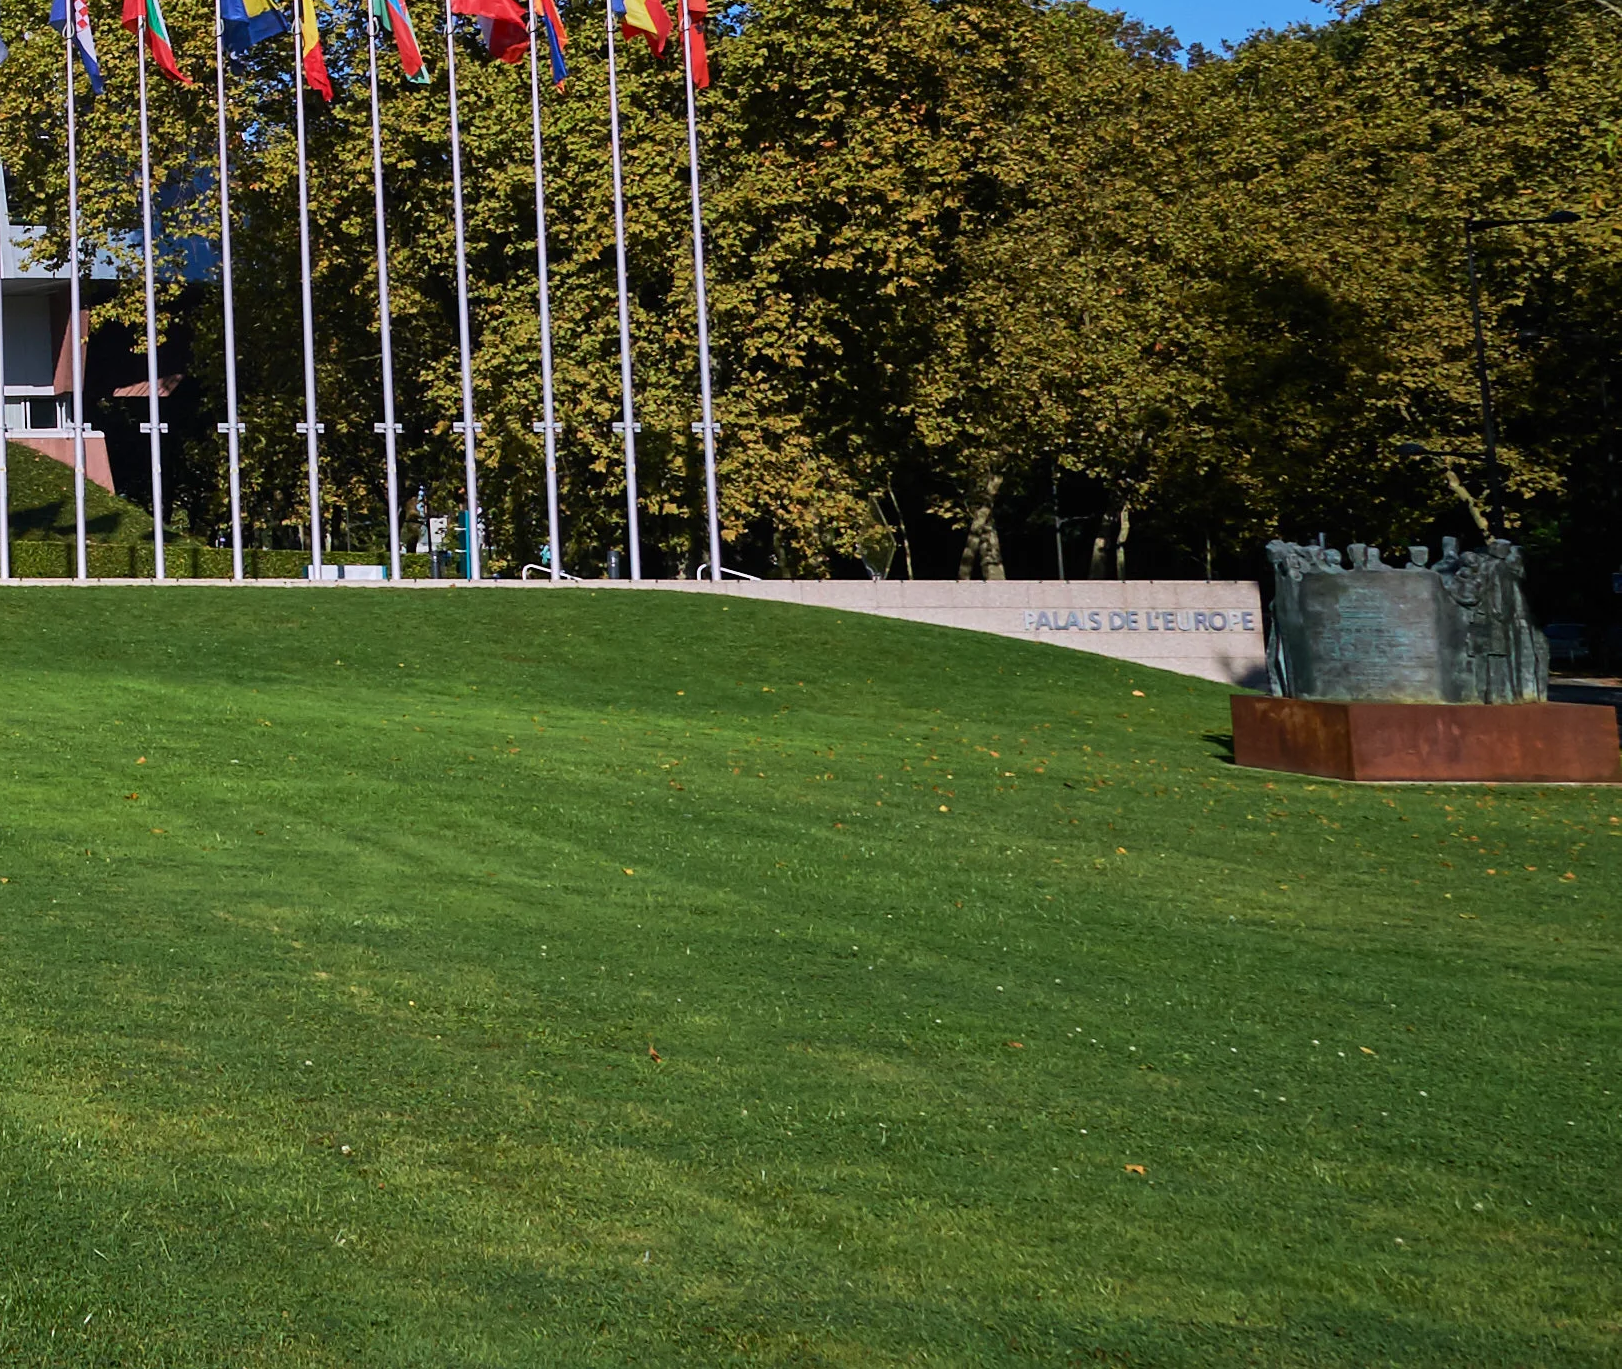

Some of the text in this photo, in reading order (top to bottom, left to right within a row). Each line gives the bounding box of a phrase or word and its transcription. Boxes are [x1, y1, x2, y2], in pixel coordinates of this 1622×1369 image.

[1023, 610, 1255, 631] PALAIS DE L'EUROPE
